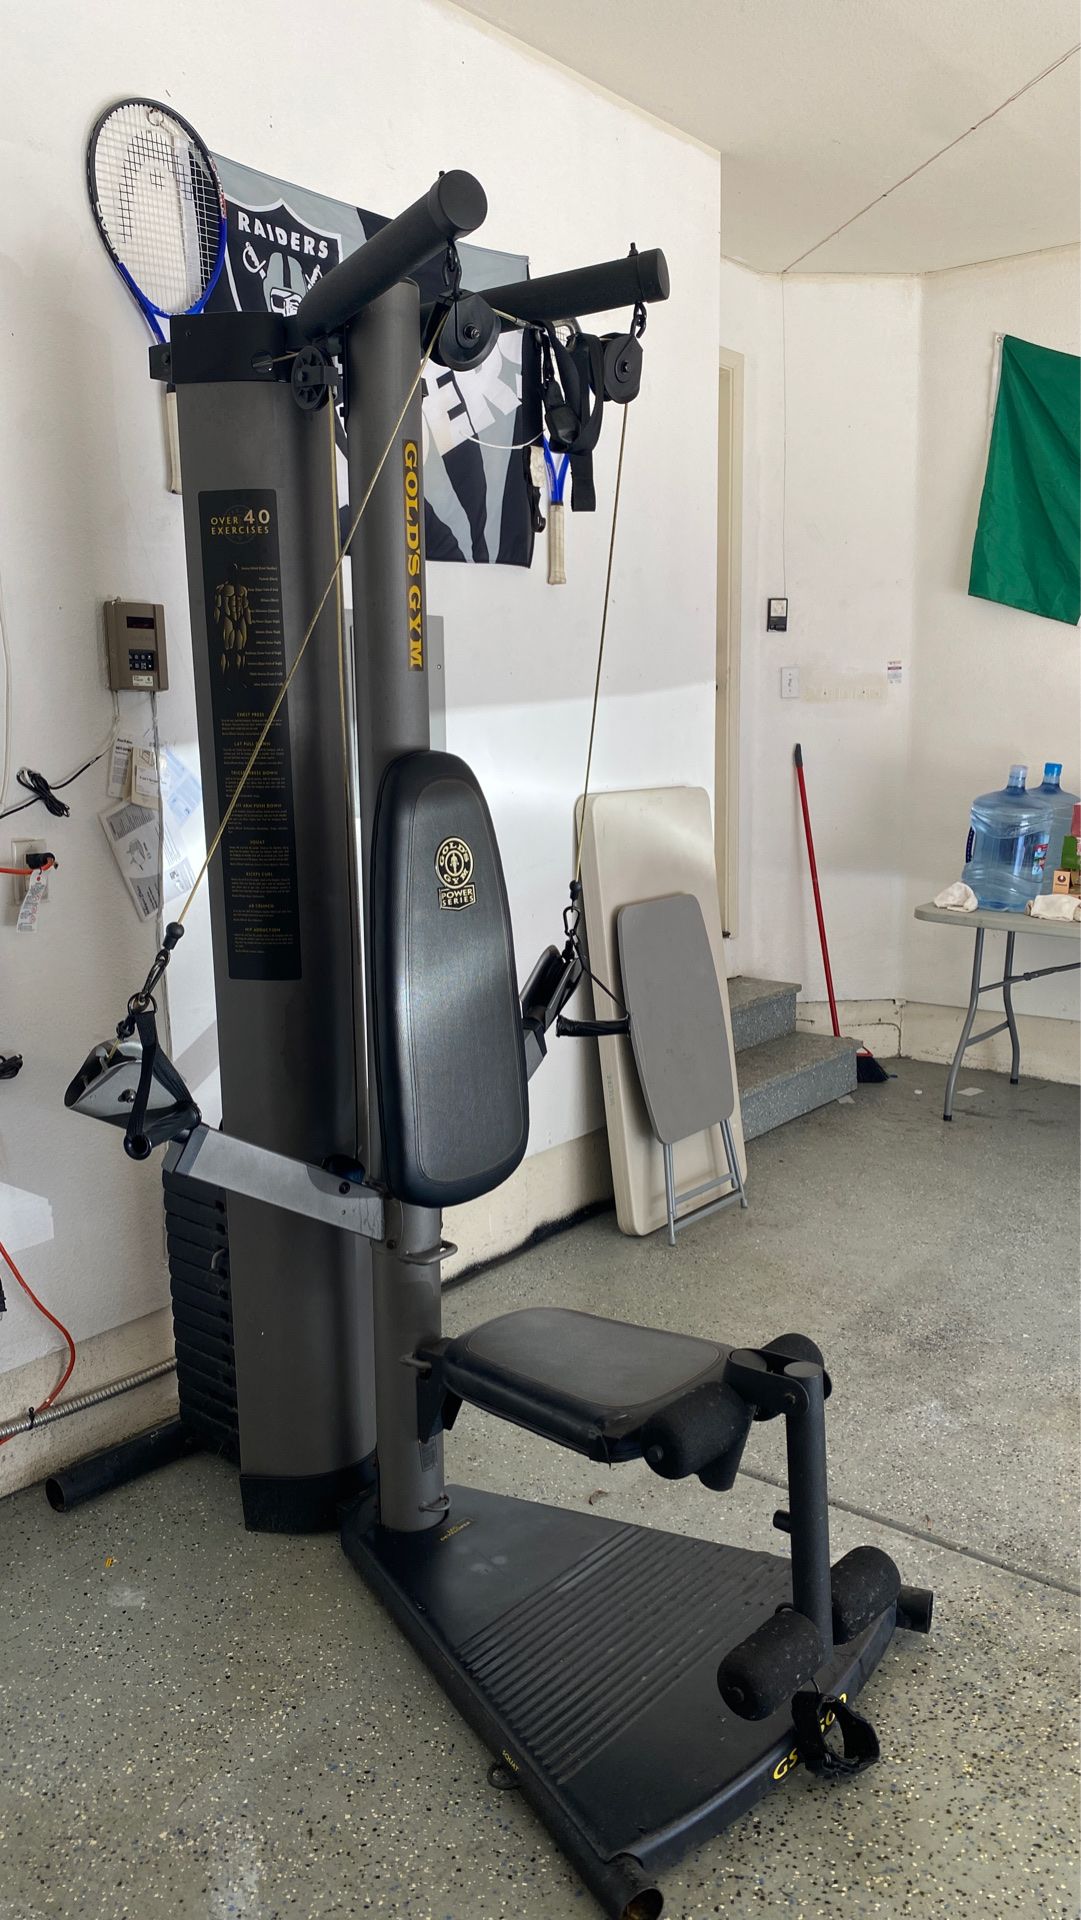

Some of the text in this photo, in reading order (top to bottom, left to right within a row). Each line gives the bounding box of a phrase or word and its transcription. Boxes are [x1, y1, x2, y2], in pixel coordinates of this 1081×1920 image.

[237, 210, 330, 259] RAIDERS
[210, 508, 271, 525] OVER 40
[211, 525, 270, 536] EXERCISES
[403, 441, 424, 668] GOLD'S GYM
[439, 842, 470, 867] GOLD'S
[443, 868, 469, 885] GYM
[441, 888, 473, 899] POWER
[442, 895, 474, 907] SERIES
